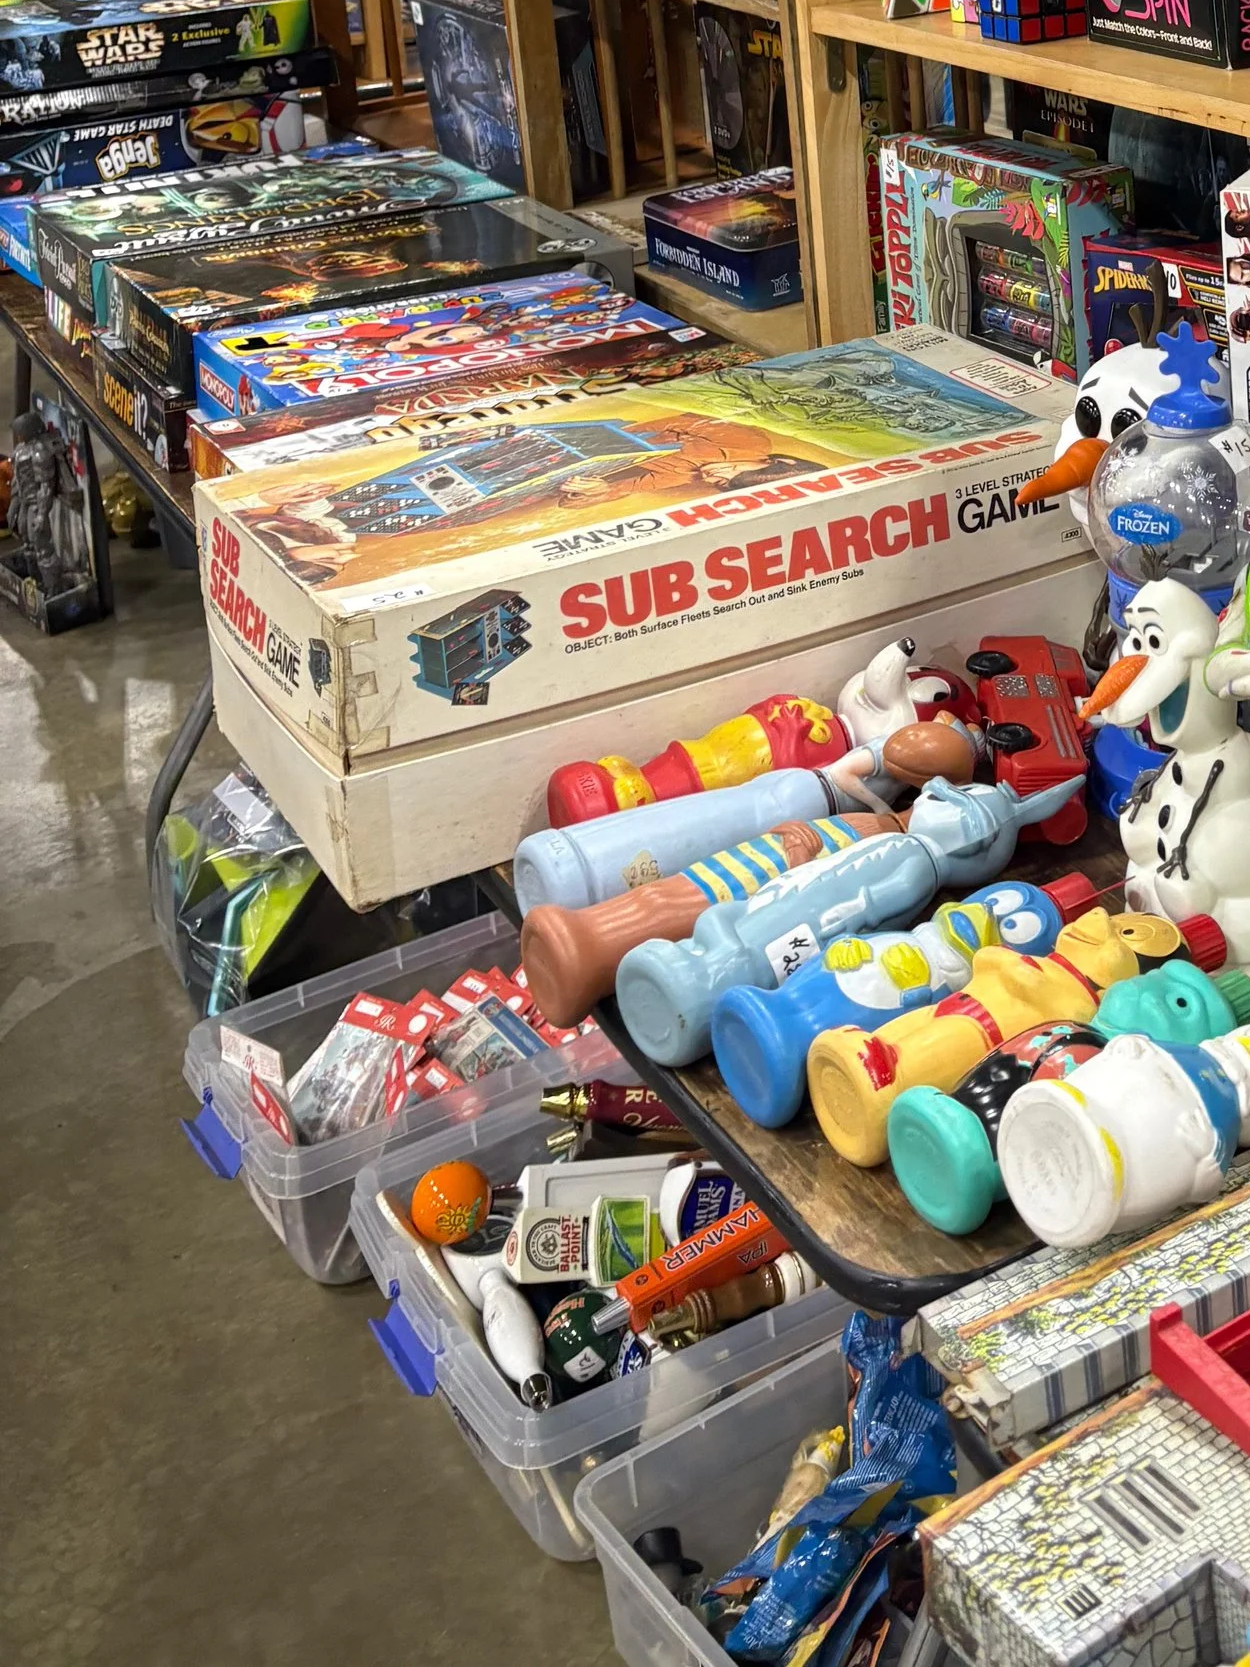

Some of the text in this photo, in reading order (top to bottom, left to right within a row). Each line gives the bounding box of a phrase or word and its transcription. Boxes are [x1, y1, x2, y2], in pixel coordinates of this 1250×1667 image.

[76, 40, 164, 68] WARS
[86, 21, 164, 49] STAR
[180, 25, 231, 42] Exclusive
[1092, 16, 1105, 29] Just
[1104, 19, 1124, 33] Match
[1124, 22, 1136, 34] the
[1180, 33, 1193, 47] and
[1040, 109, 1086, 131] EPISODE
[1044, 90, 1088, 117] WARS
[72, 114, 174, 143] DEATH STAR GAME
[98, 132, 160, 180] Jenga
[654, 237, 741, 288] FORBIDDEN ISLAND
[102, 371, 134, 427] scene
[200, 365, 236, 414] MONOPOLY
[666, 430, 1043, 529] SUB SEARCH
[955, 478, 999, 499] 3 LEVEL
[211, 516, 241, 579] SUB
[532, 516, 664, 563] GAME
[1116, 516, 1170, 536] FROZEN
[559, 492, 951, 640] SUB SEARCH
[209, 556, 268, 655] SEARCH
[564, 566, 865, 655] OBJECT: Both Surface Fleets Search Out and Sink Enemy Subs
[266, 632, 301, 689] GAME
[559, 1216, 572, 1273] BALLAST
[571, 1222, 581, 1264] POINT
[738, 1239, 769, 1265] IPA
